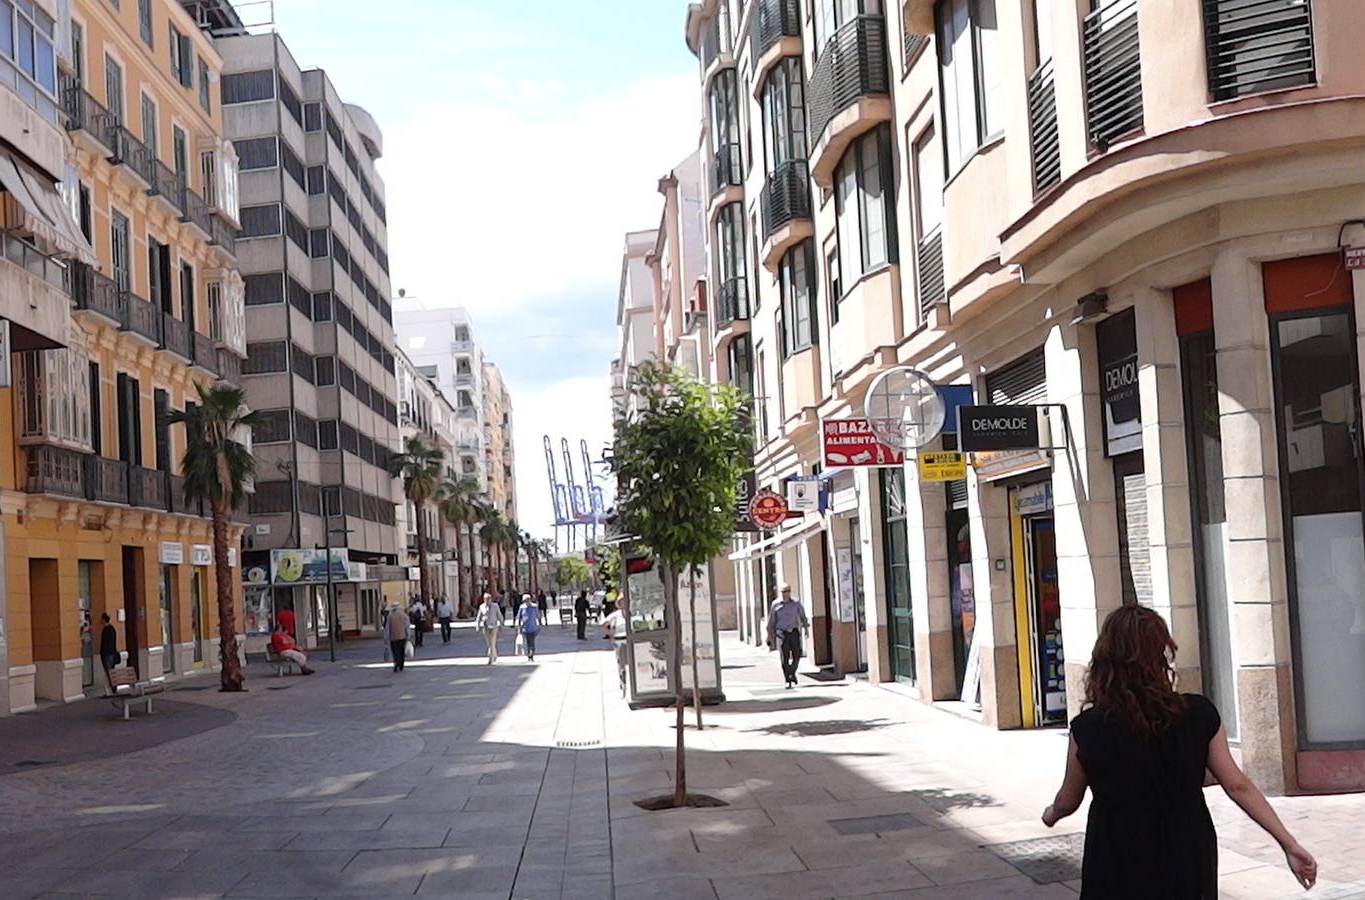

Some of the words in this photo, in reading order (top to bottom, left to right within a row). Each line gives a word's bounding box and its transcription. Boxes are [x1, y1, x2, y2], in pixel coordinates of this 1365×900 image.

[1105, 361, 1138, 391] DEMOL
[971, 417, 1028, 431] DEMOLDE
[825, 435, 894, 445] ALIMENTA
